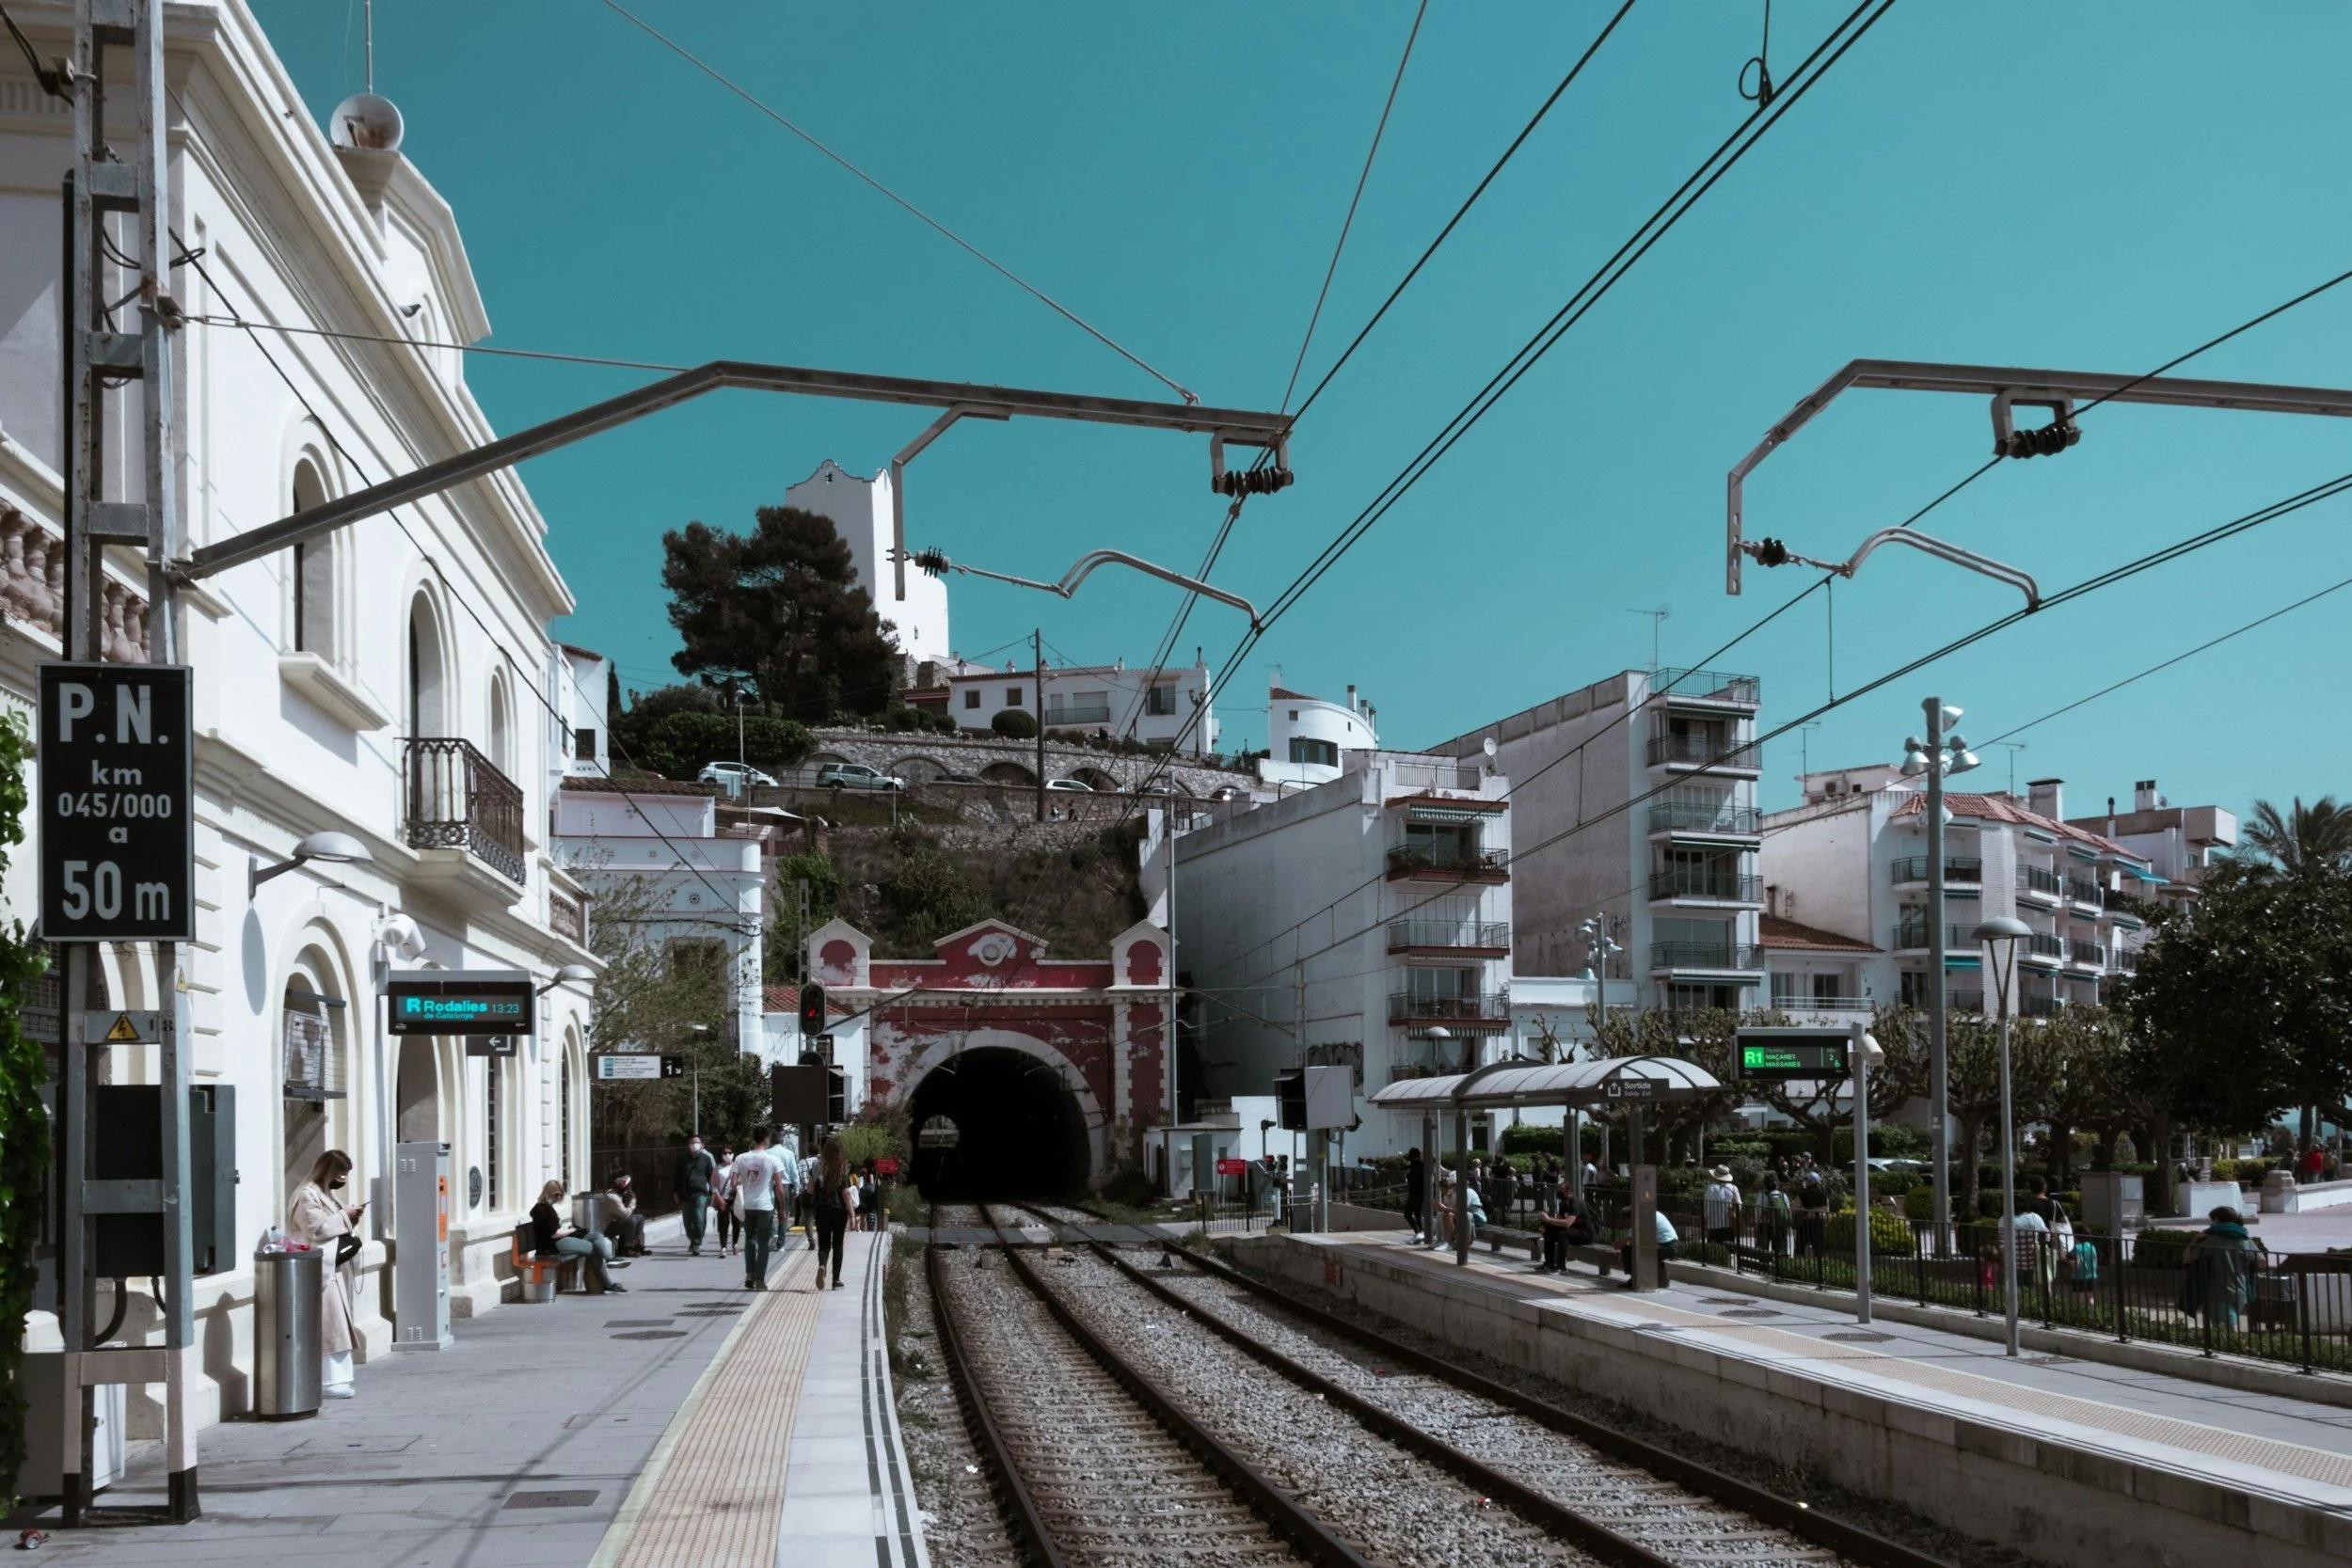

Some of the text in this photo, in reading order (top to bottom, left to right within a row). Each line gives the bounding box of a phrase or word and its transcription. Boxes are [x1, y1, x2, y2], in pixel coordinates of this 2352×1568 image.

[59, 682, 168, 745] P.N.
[91, 759, 142, 785] km
[57, 792, 172, 818] 045/000
[108, 826, 128, 844] a
[62, 860, 170, 921] 50 m
[406, 997, 421, 1012] R
[423, 1000, 520, 1014] Rodalies 13:23
[436, 1012, 474, 1021] Catalunya
[1744, 1051, 1762, 1064] R1
[666, 1065, 673, 1075] 1
